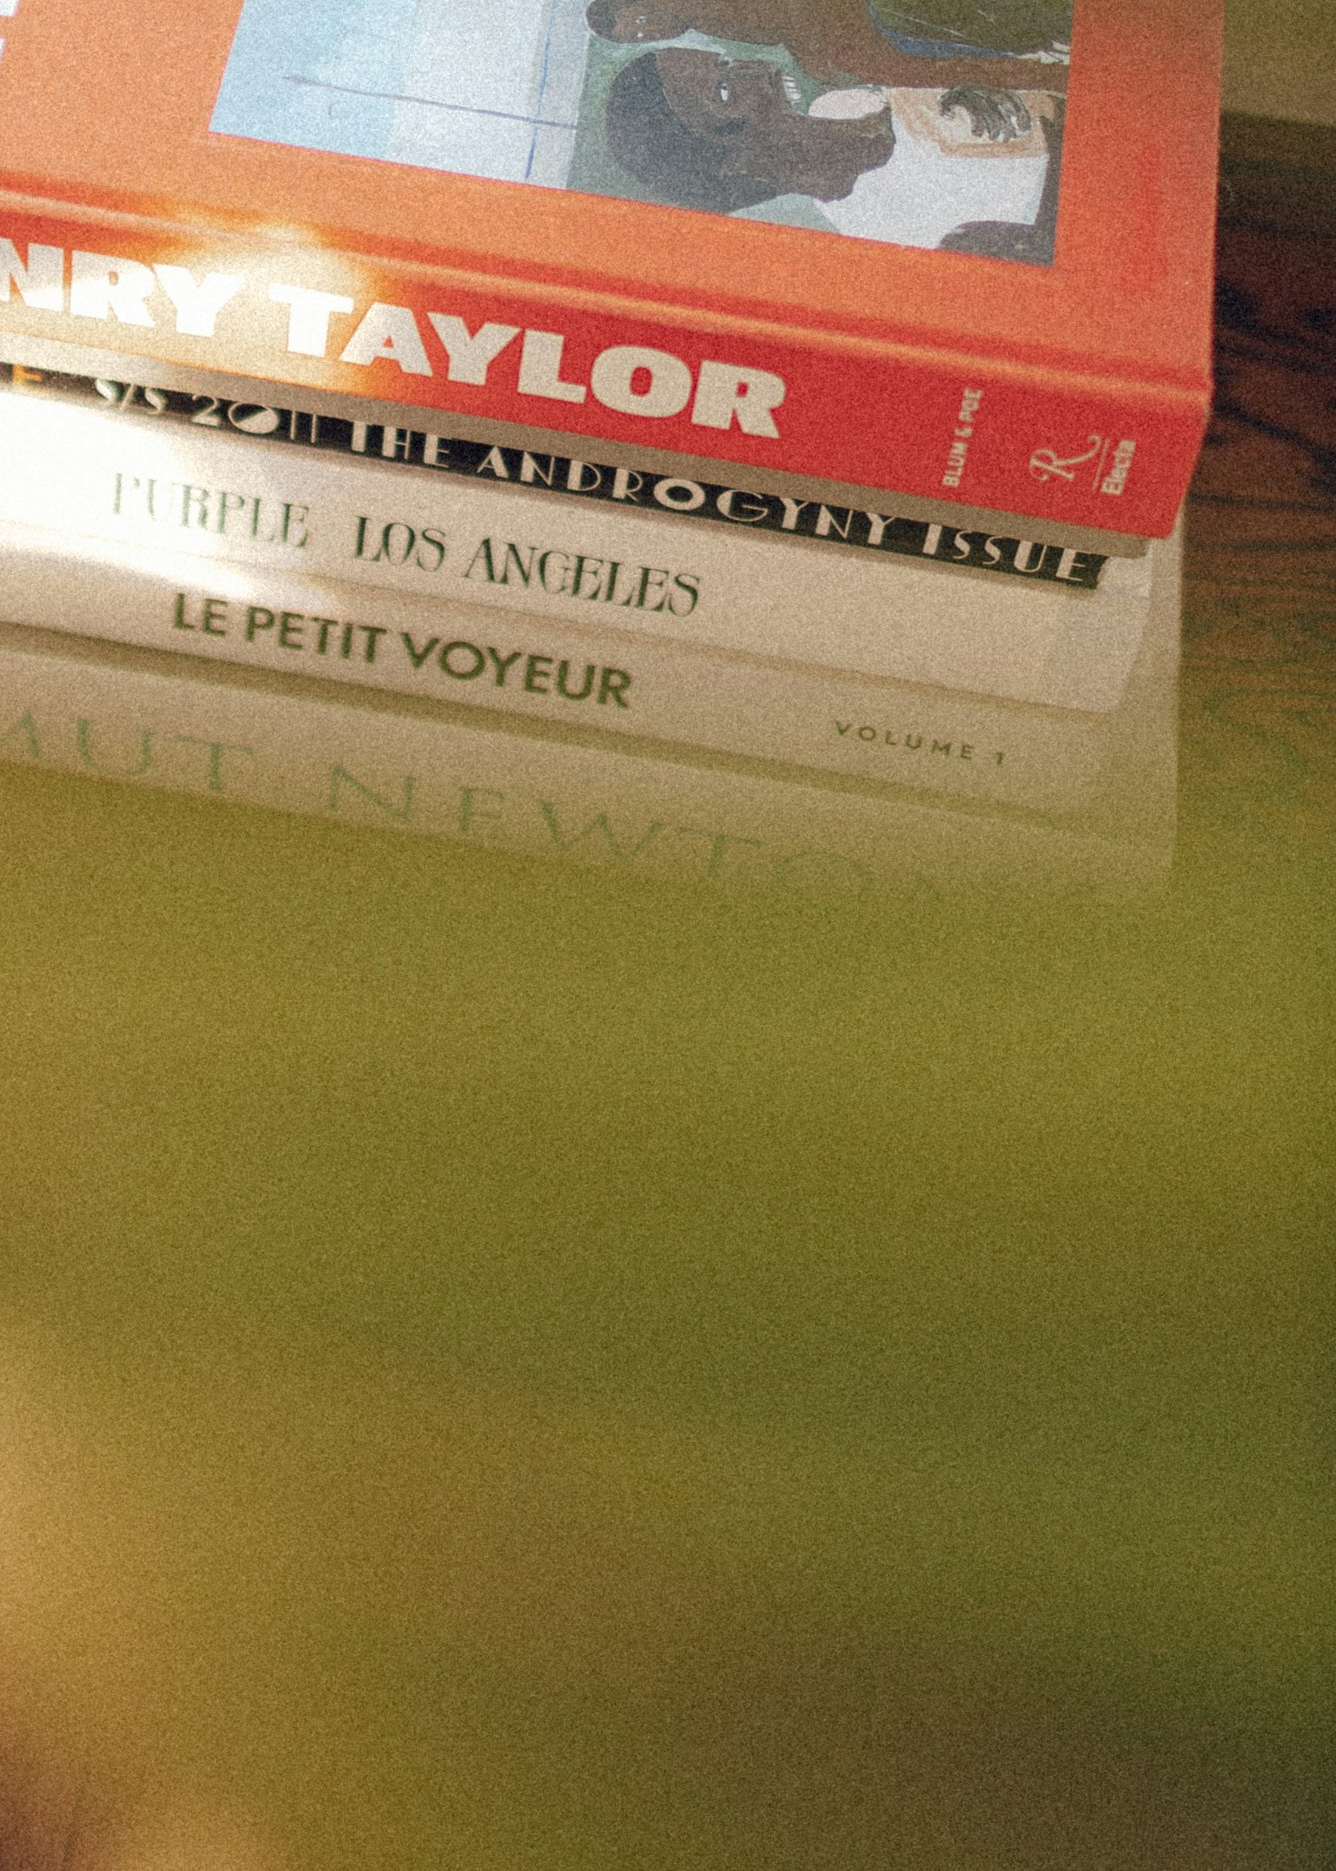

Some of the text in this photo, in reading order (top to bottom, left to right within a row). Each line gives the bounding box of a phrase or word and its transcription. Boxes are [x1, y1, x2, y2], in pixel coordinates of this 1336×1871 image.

[268, 284, 786, 440] TAYLOR
[95, 377, 167, 415] S/S
[190, 393, 318, 443] 2011
[350, 420, 450, 469] THE
[476, 445, 896, 545] ANDROGYNY
[922, 523, 1089, 582] ISSUE
[942, 386, 983, 488] BLUM & POE
[1101, 439, 1137, 496] Electa
[113, 472, 701, 617] PURPLE LOS ANGELES
[172, 592, 633, 710] LE PETIT VOYEUR
[834, 721, 1005, 767] VOLUME 1
